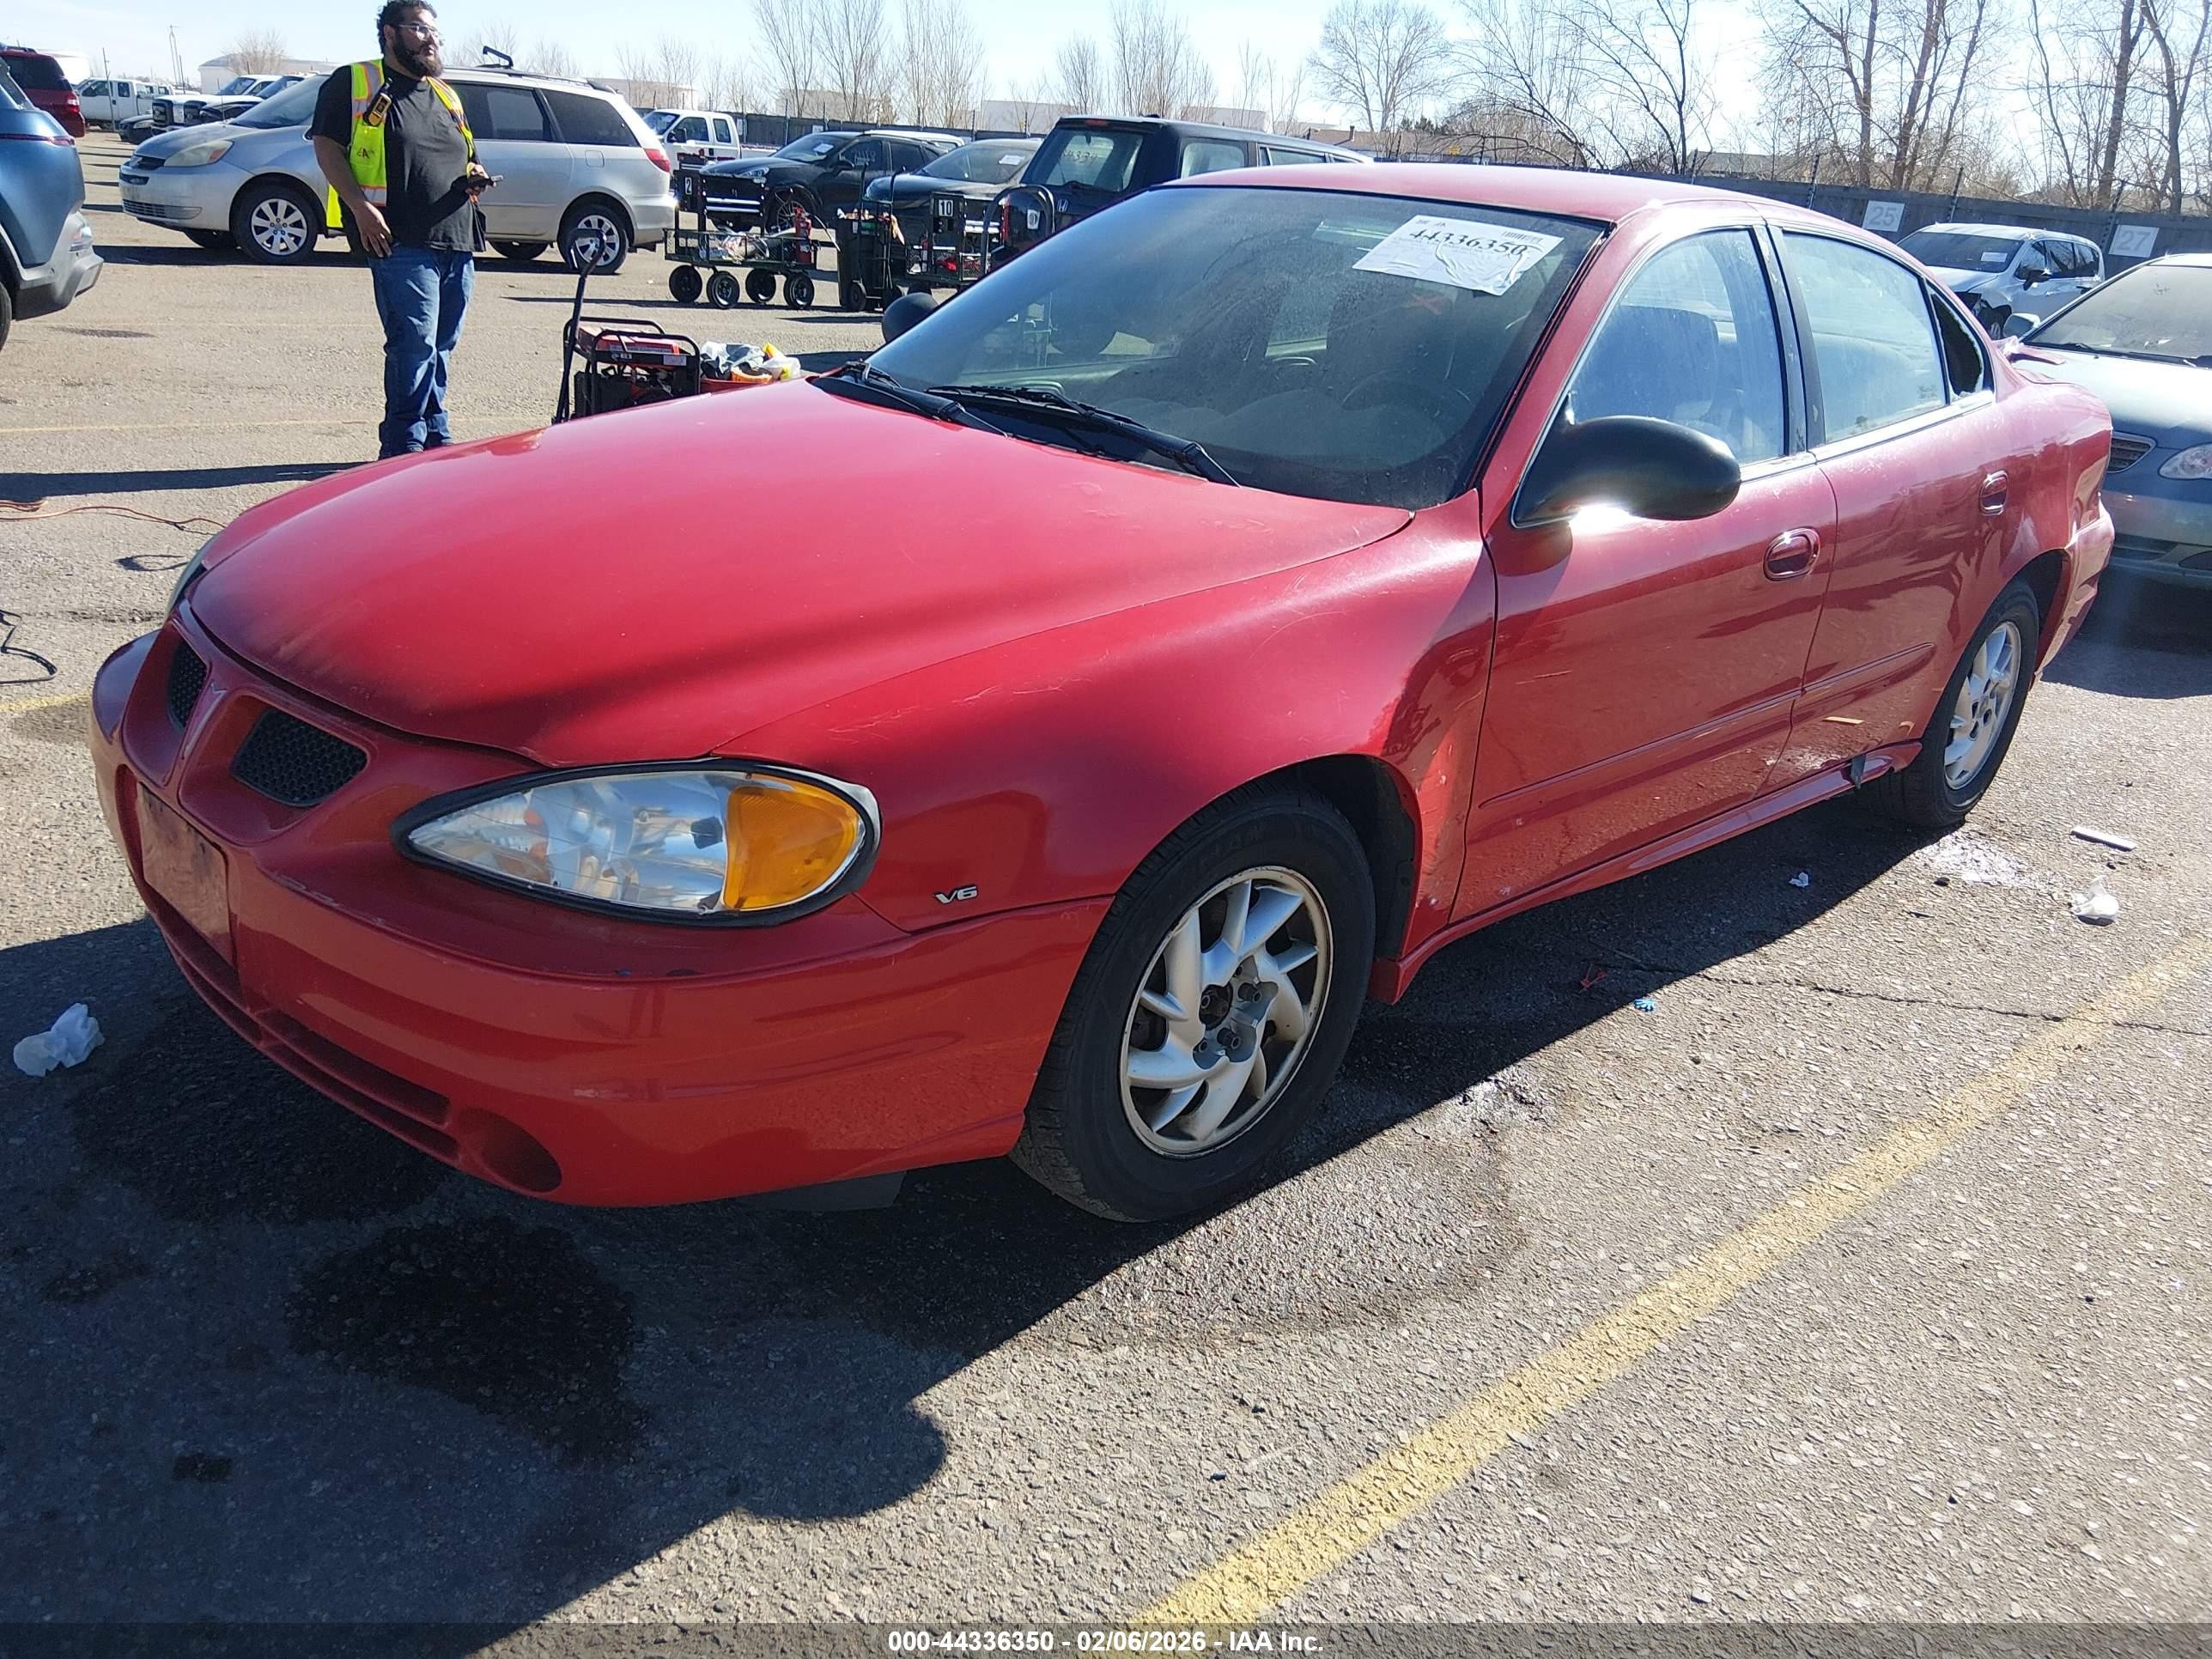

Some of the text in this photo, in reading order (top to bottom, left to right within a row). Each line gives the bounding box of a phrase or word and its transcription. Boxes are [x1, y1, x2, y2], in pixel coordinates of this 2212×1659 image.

[940, 200, 952, 216] 10
[1869, 205, 1897, 226] 25
[1409, 228, 1528, 256] 44336350
[2118, 229, 2151, 252] 27
[934, 885, 978, 903] V6
